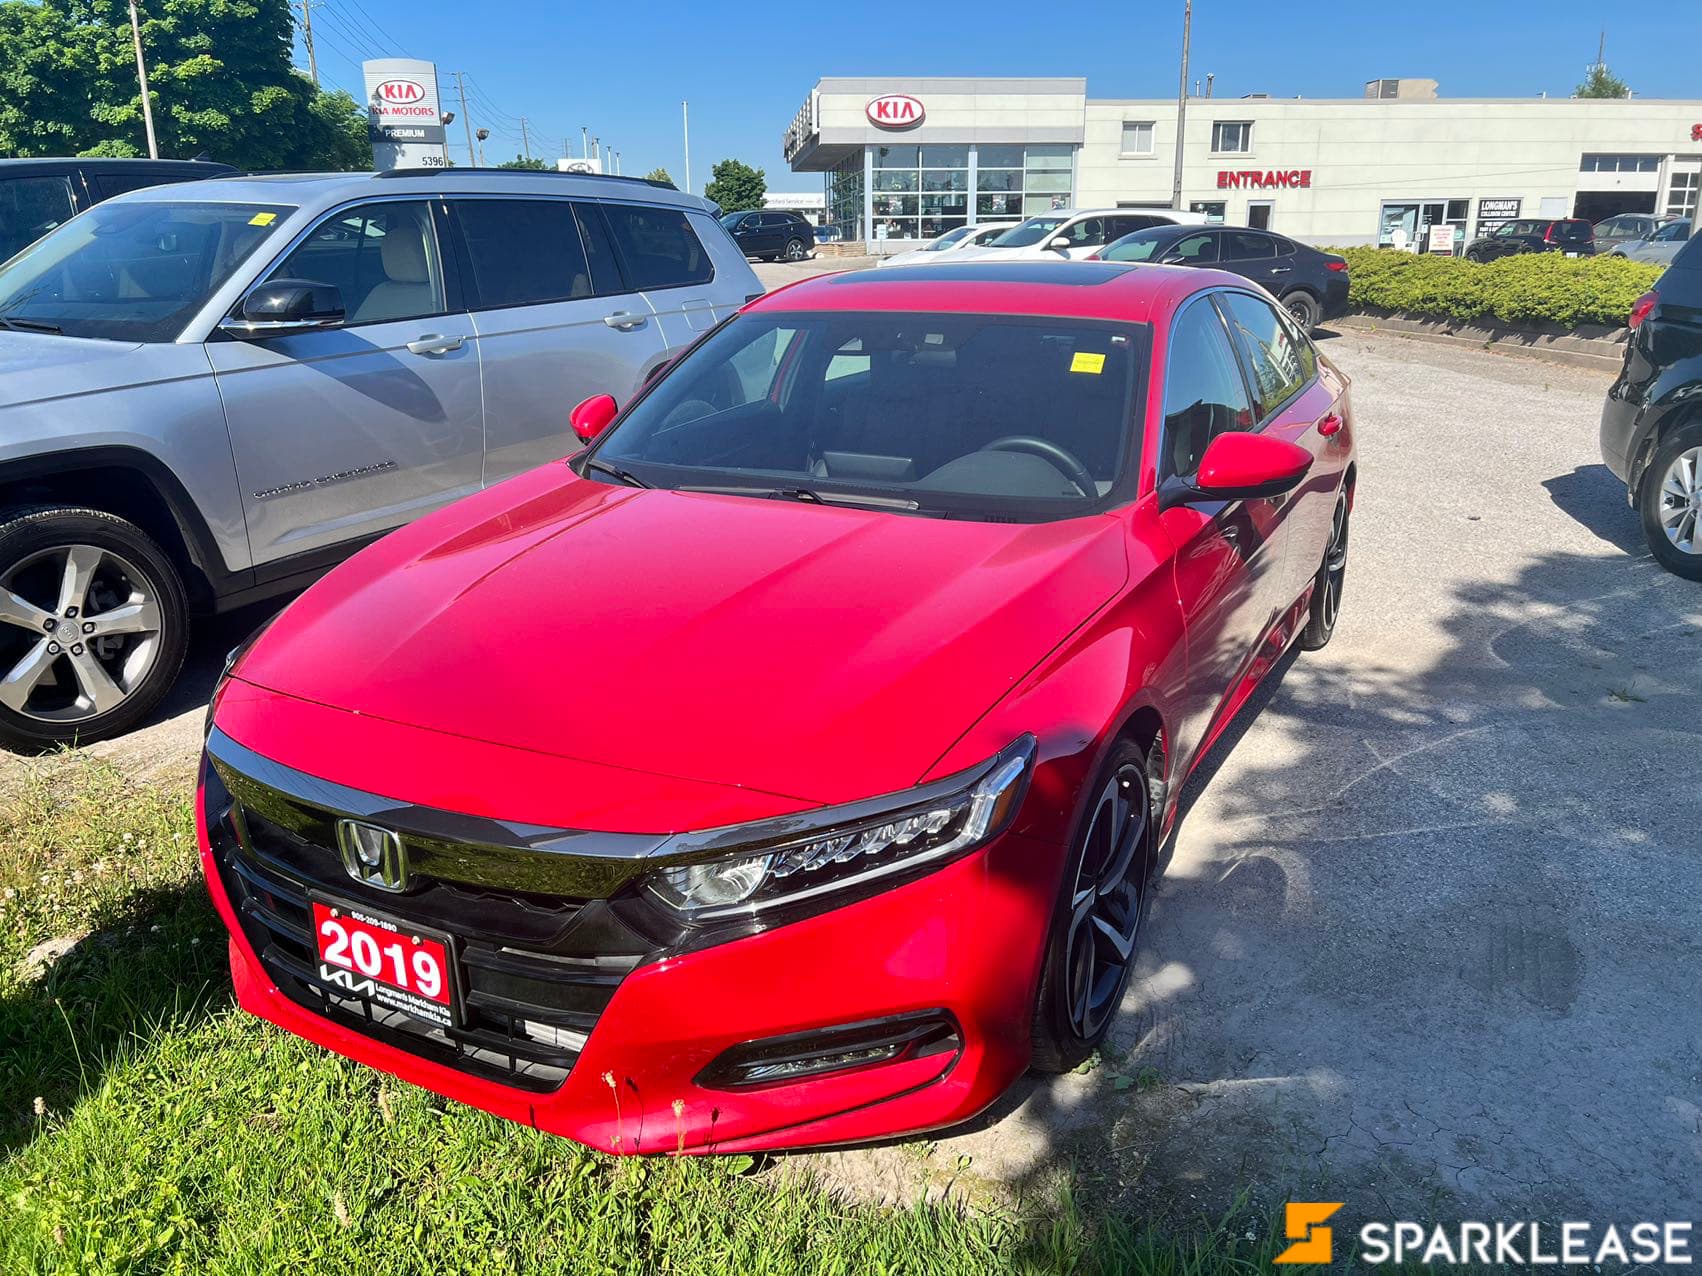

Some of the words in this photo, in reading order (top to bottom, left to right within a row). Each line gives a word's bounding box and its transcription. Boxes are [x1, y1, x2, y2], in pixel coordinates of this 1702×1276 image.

[384, 84, 417, 99] KIA
[372, 106, 389, 115] KIA
[391, 107, 434, 116] MOTORS
[877, 101, 914, 118] KIA
[385, 129, 425, 137] PREMIUM
[422, 156, 444, 167] 5396
[1217, 170, 1312, 189] ENTRANCE
[1481, 201, 1518, 211] LONGMAN'S
[320, 920, 442, 998] 2019
[319, 964, 375, 997] KIA
